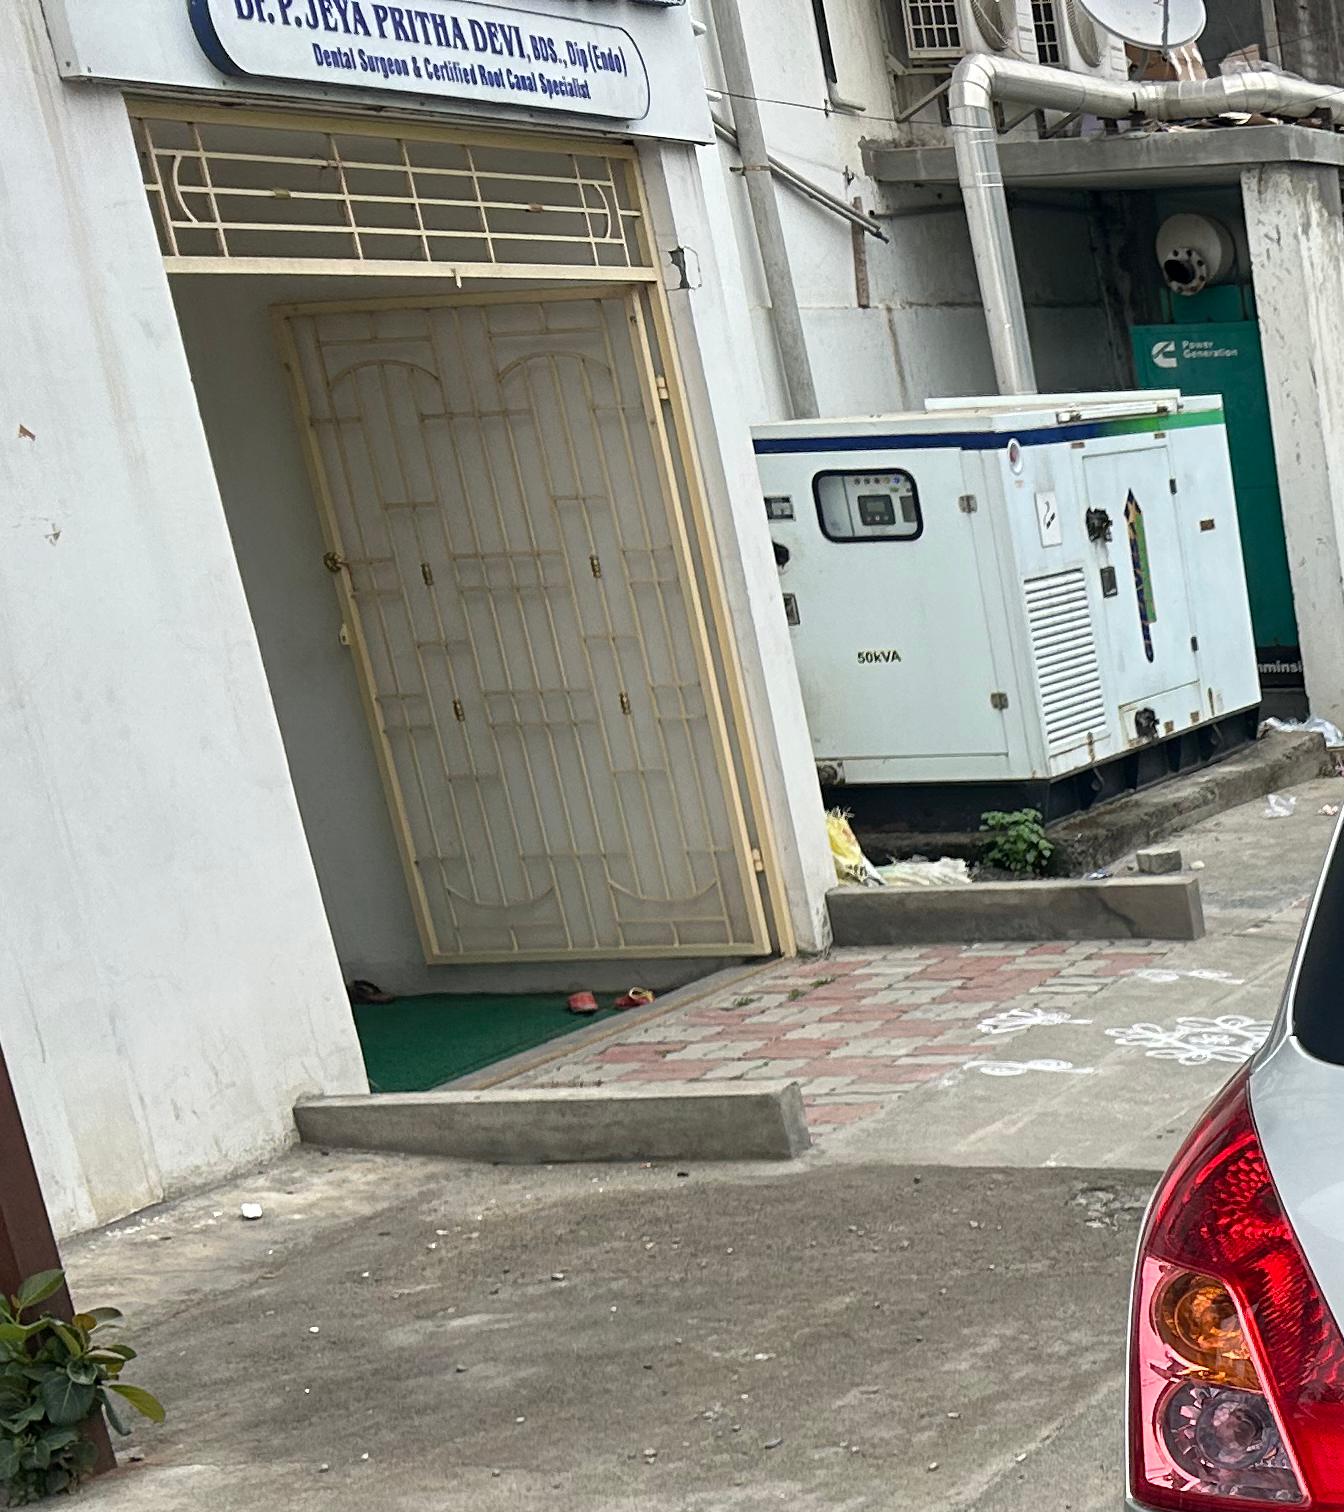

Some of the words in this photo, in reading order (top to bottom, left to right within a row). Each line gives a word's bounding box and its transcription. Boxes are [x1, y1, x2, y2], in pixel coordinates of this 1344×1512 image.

[372, 4, 469, 50] PRITHA
[312, 42, 356, 71] Dental
[357, 48, 410, 79] Surgeon
[411, 56, 423, 79] &
[423, 57, 478, 86] Certified
[480, 64, 506, 89] Root
[506, 68, 538, 93] Canal
[538, 73, 592, 100] Specialist
[857, 650, 902, 665] 50kVA
